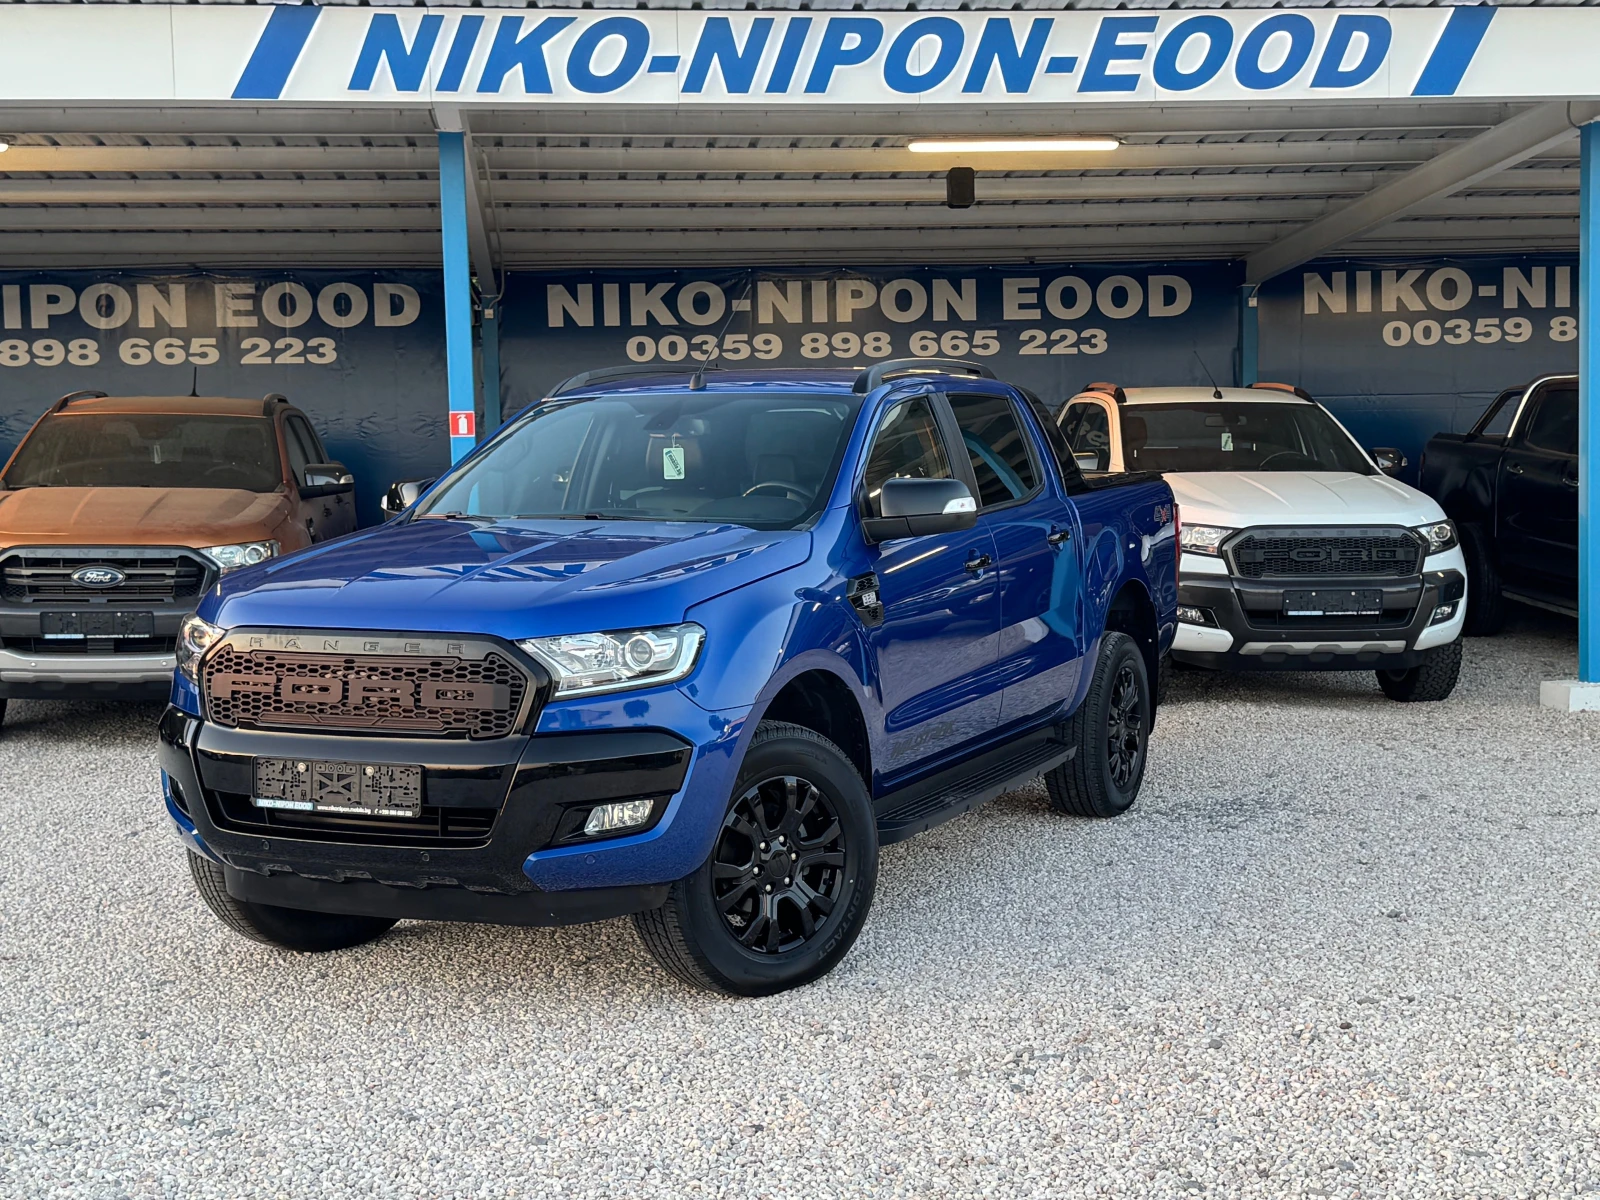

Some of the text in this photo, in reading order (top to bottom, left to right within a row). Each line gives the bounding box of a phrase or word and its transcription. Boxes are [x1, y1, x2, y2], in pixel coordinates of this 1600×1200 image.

[349, 15, 1391, 93] NIKO-NIPON-EOOD
[214, 281, 421, 329] EOOD
[547, 275, 1192, 327] NIKO-NIPON EOOD
[626, 329, 1109, 362] 00359 898 665 223
[1382, 316, 1578, 347] 00359 8
[0, 337, 338, 367] 898 665 223
[83, 570, 113, 583] Ford
[249, 636, 465, 655] RANGER
[211, 672, 511, 710] FORD
